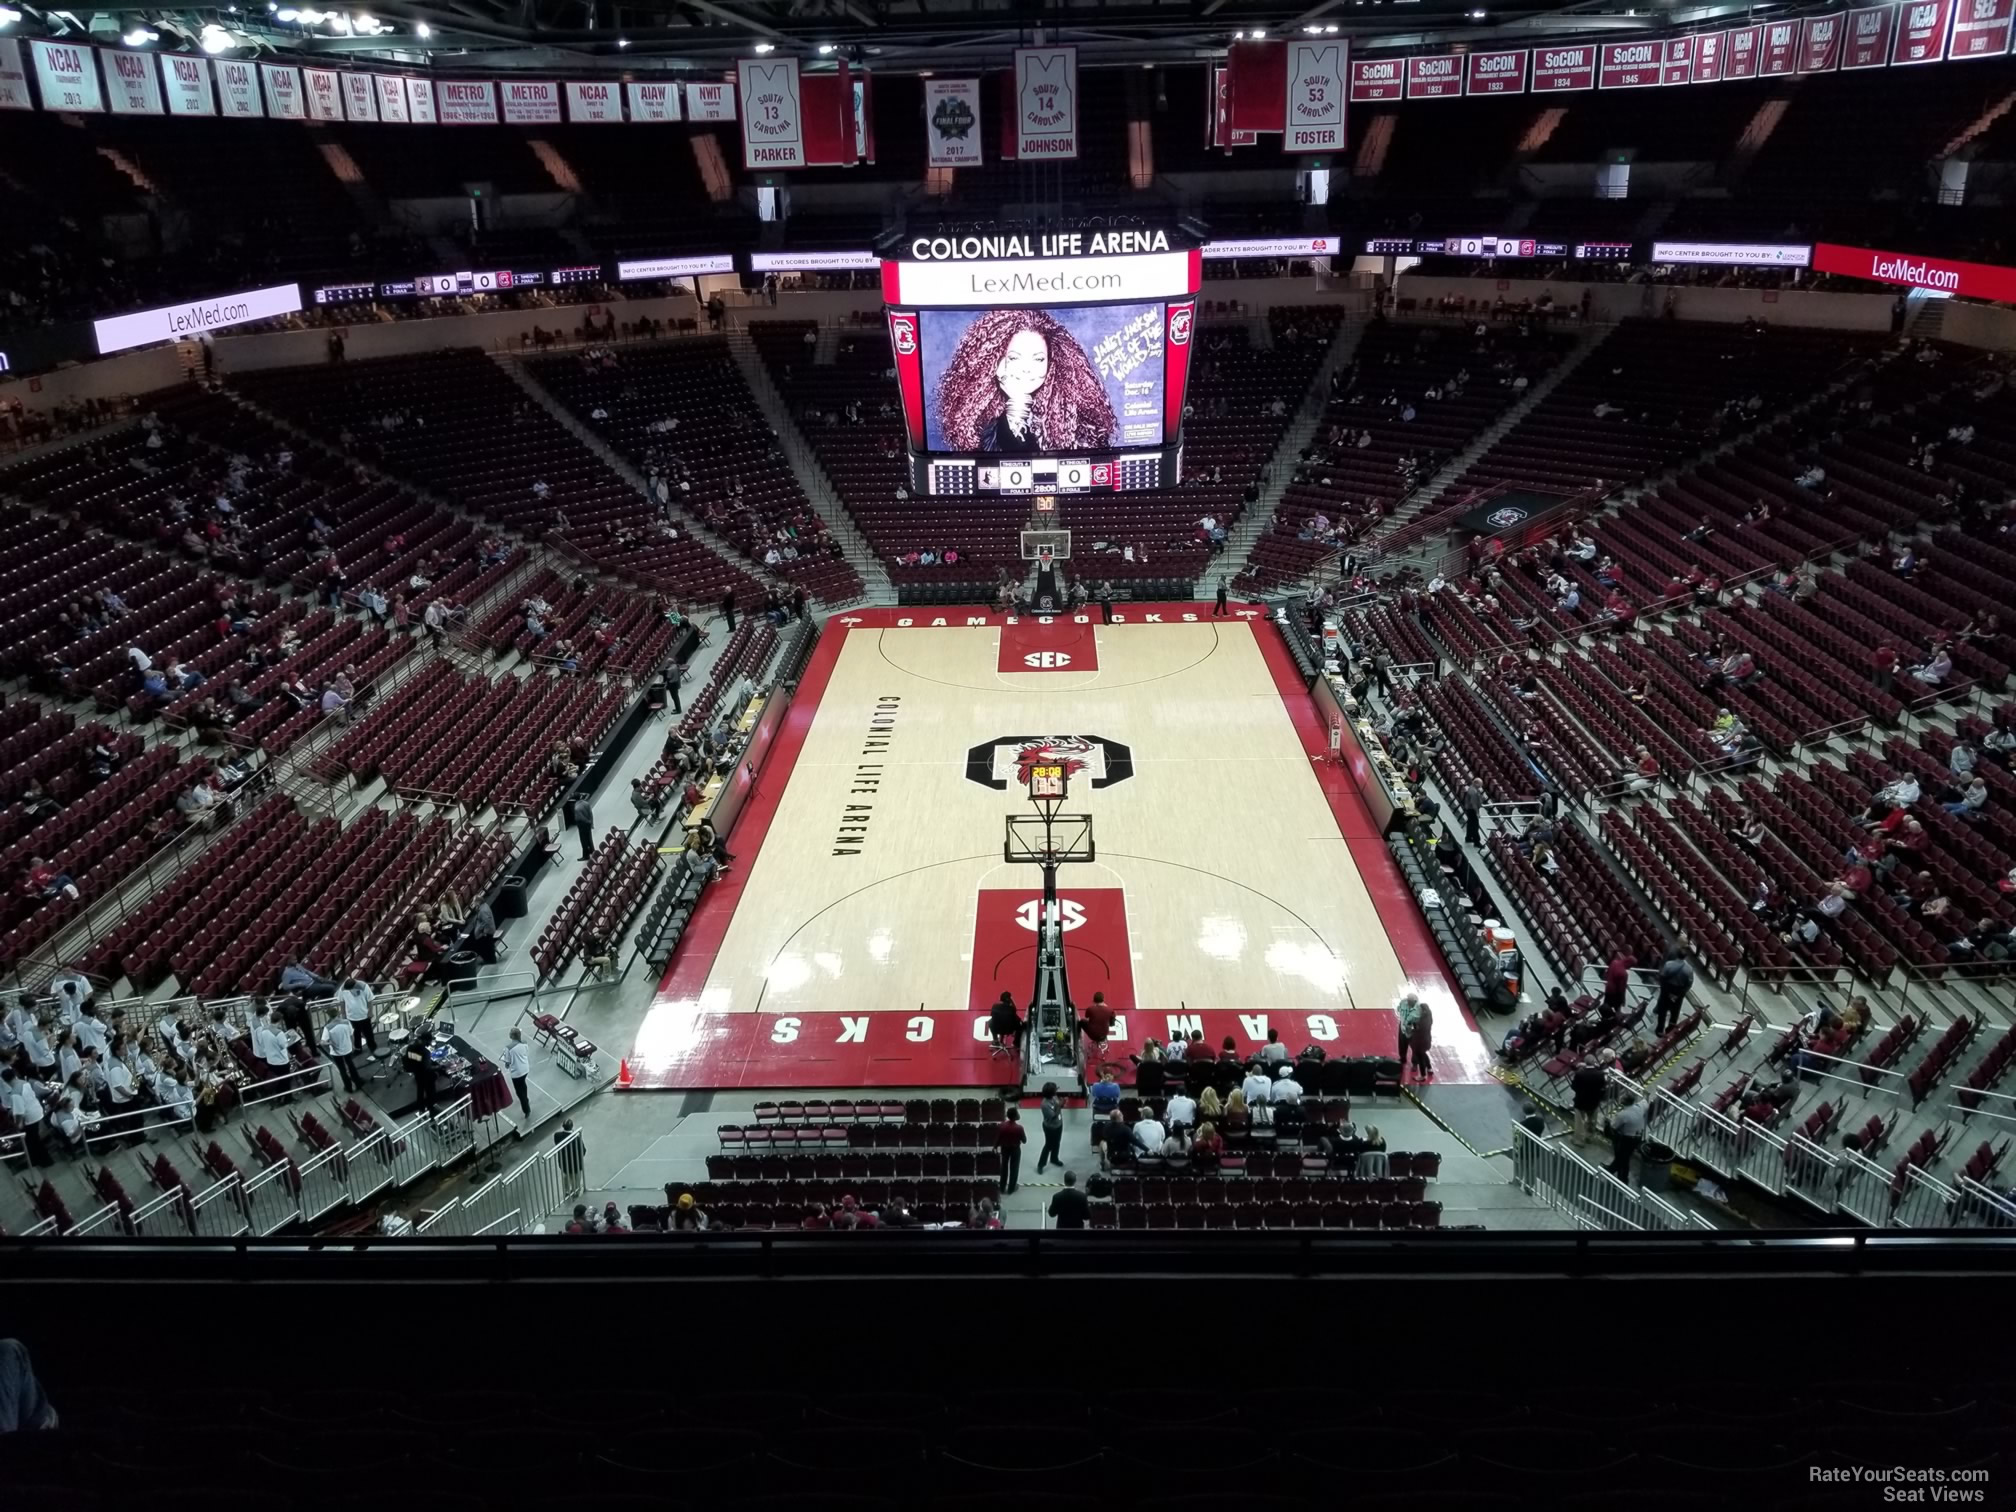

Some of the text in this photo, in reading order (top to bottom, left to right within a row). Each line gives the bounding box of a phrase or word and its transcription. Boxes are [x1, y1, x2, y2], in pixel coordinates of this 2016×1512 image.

[1856, 12, 1882, 35] NCAA
[1908, 3, 1938, 29] NCAA
[1770, 26, 1791, 46] NCAA
[1811, 21, 1834, 42] NCAA
[1734, 32, 1753, 51] NCAA
[45, 47, 83, 73] NCAA
[1545, 50, 1584, 68] SoCON
[1613, 46, 1652, 63] SoCON
[114, 54, 146, 78] NCAA
[173, 60, 200, 82] NCAA
[1419, 60, 1453, 75] SoCON
[1480, 55, 1516, 72] SoCON
[225, 65, 249, 86] NCAA
[1362, 64, 1394, 79] SoCON
[1622, 75, 1639, 83] 1945
[271, 70, 293, 89] NCAA
[312, 74, 332, 93] NCAA
[1304, 75, 1330, 87] SOUTH
[1488, 82, 1504, 90] 1933
[1554, 78, 1571, 87] 1934
[383, 80, 398, 97] NCAA
[413, 83, 428, 98] NCAA
[447, 85, 485, 100] METRO
[511, 85, 548, 100] METRO
[579, 86, 608, 100] NCAA
[641, 86, 666, 100] AIAW
[699, 86, 722, 100] NWIT
[1033, 84, 1059, 96] SOUTH
[1309, 88, 1324, 102] 53
[1427, 86, 1442, 94] 1933
[64, 92, 82, 105] 2013
[129, 96, 145, 108] 2012
[758, 93, 784, 105] SOUTH
[1038, 96, 1054, 111] 14
[706, 110, 720, 118] 1979
[764, 106, 779, 120] 13
[1297, 102, 1335, 117] CAROLINA
[936, 117, 954, 125] FINAL
[1027, 110, 1066, 126] CAROLINA
[753, 119, 791, 135] CAROLINA
[1295, 130, 1335, 144] FOSTER
[946, 146, 964, 155] 2017
[1022, 138, 1073, 153] JOHNSON
[754, 147, 796, 162] PARKER
[912, 230, 1169, 260] COLONIAL LIFE ARENA
[1467, 241, 1476, 253] 0
[1504, 242, 1512, 254] 0
[1872, 255, 1959, 289] LexMed.com
[441, 278, 450, 290] 0
[480, 275, 490, 288] 0
[971, 272, 1121, 293] LexMed.com
[168, 302, 249, 333] LexMed.com
[1093, 306, 1158, 364] JANET JACKSON
[1100, 347, 1129, 381] STATE
[1127, 337, 1140, 353] OF
[1113, 350, 1148, 382] WORLD
[1124, 381, 1154, 390] Saturday
[1124, 401, 1152, 410] Colonial
[1137, 408, 1158, 416] Arena
[1010, 471, 1022, 485] 0
[1069, 469, 1081, 483] 0
[1024, 651, 1072, 668] SEC
[832, 696, 901, 856] COLONIAL LIFE ARENA
[1033, 767, 1061, 777] 28:08
[771, 1013, 1339, 1044] GAMEOCKS
